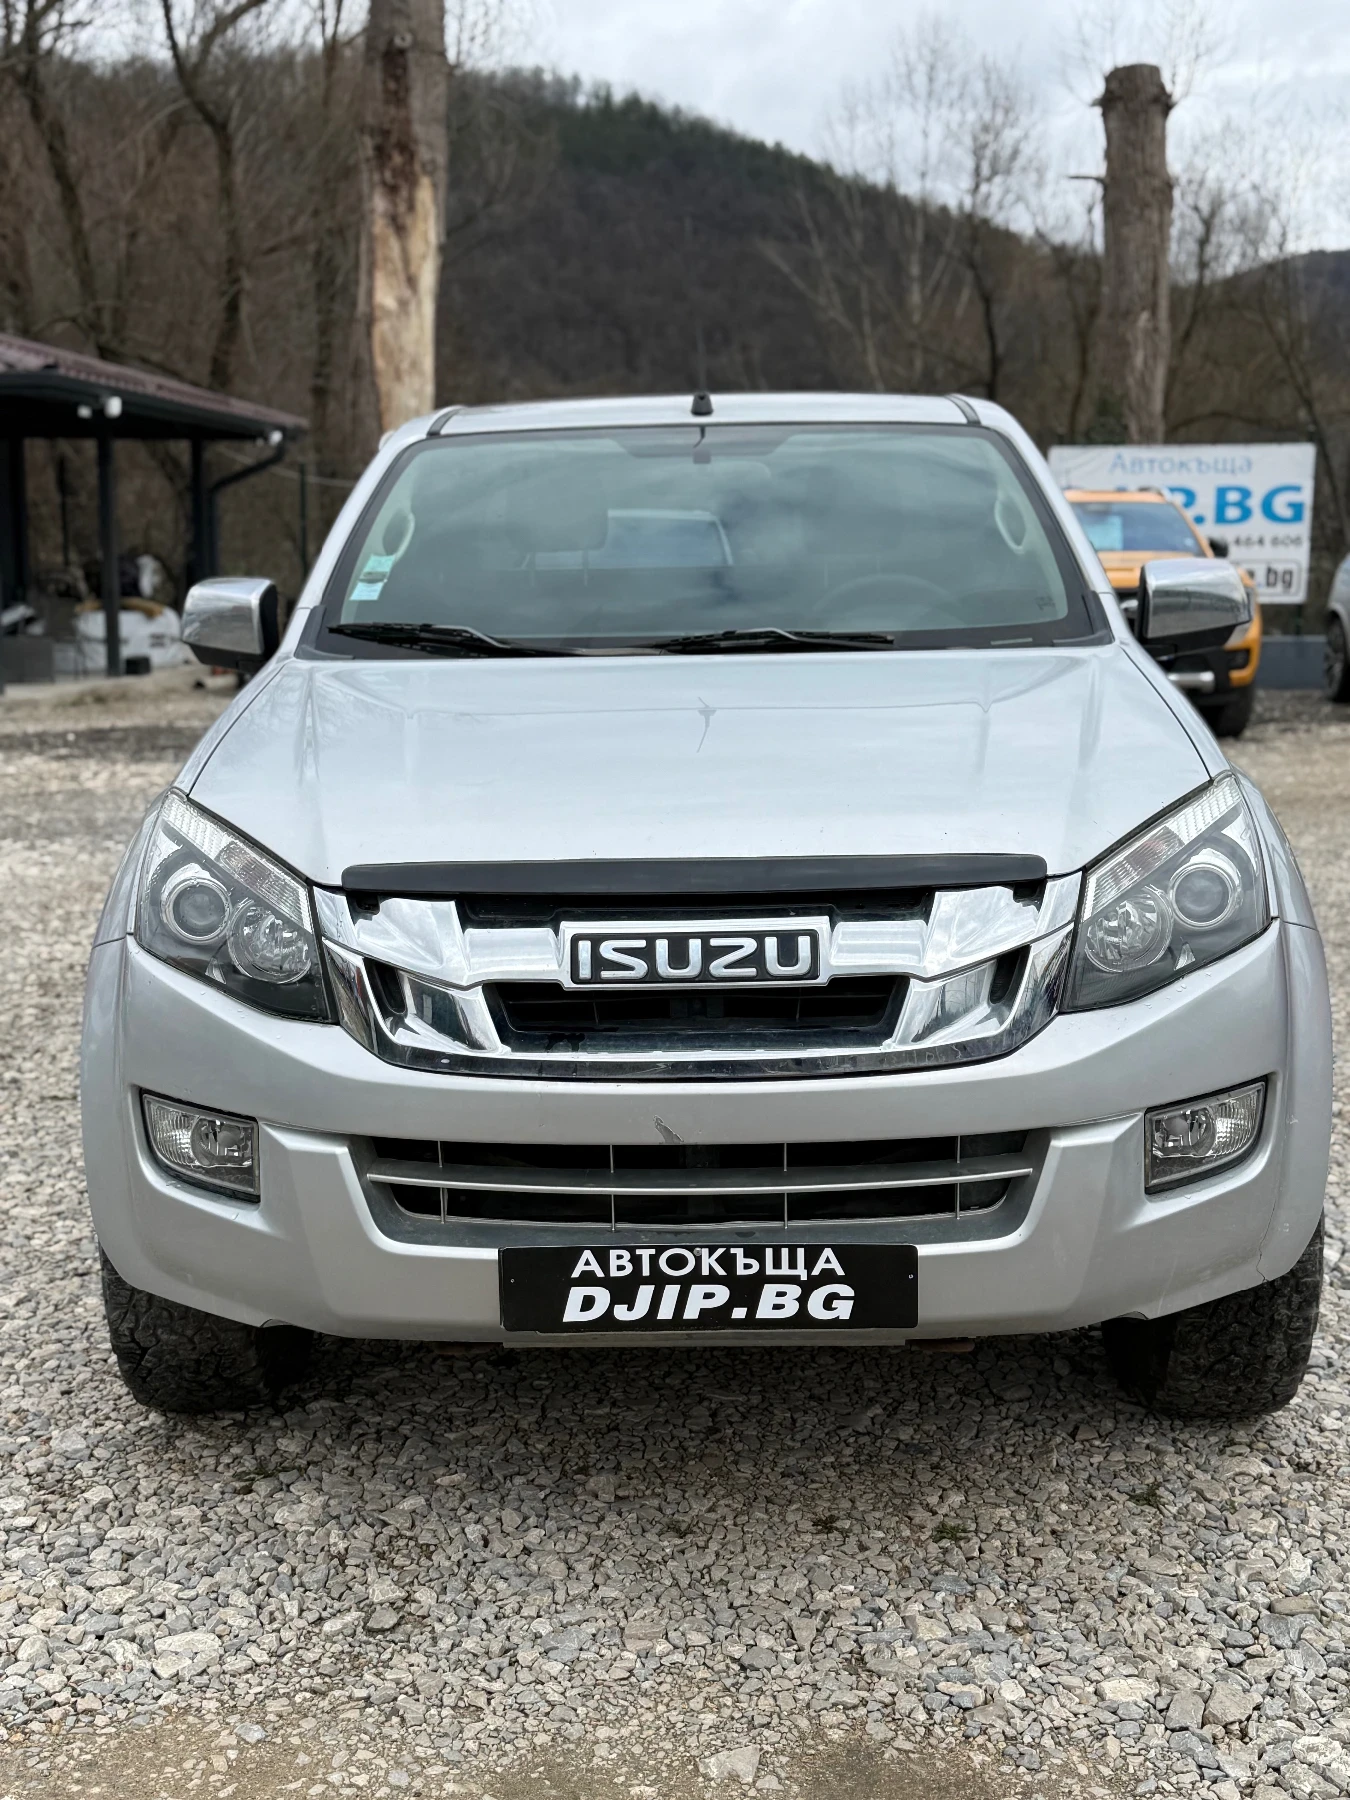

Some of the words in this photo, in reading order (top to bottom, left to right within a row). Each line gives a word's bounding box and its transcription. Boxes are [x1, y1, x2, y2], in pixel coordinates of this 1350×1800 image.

[1108, 453, 1252, 475] Автокъща
[578, 936, 811, 980] ISUZU
[571, 1247, 845, 1280] АВТОКЪЩА
[562, 1284, 855, 1322] DJIP.BG
